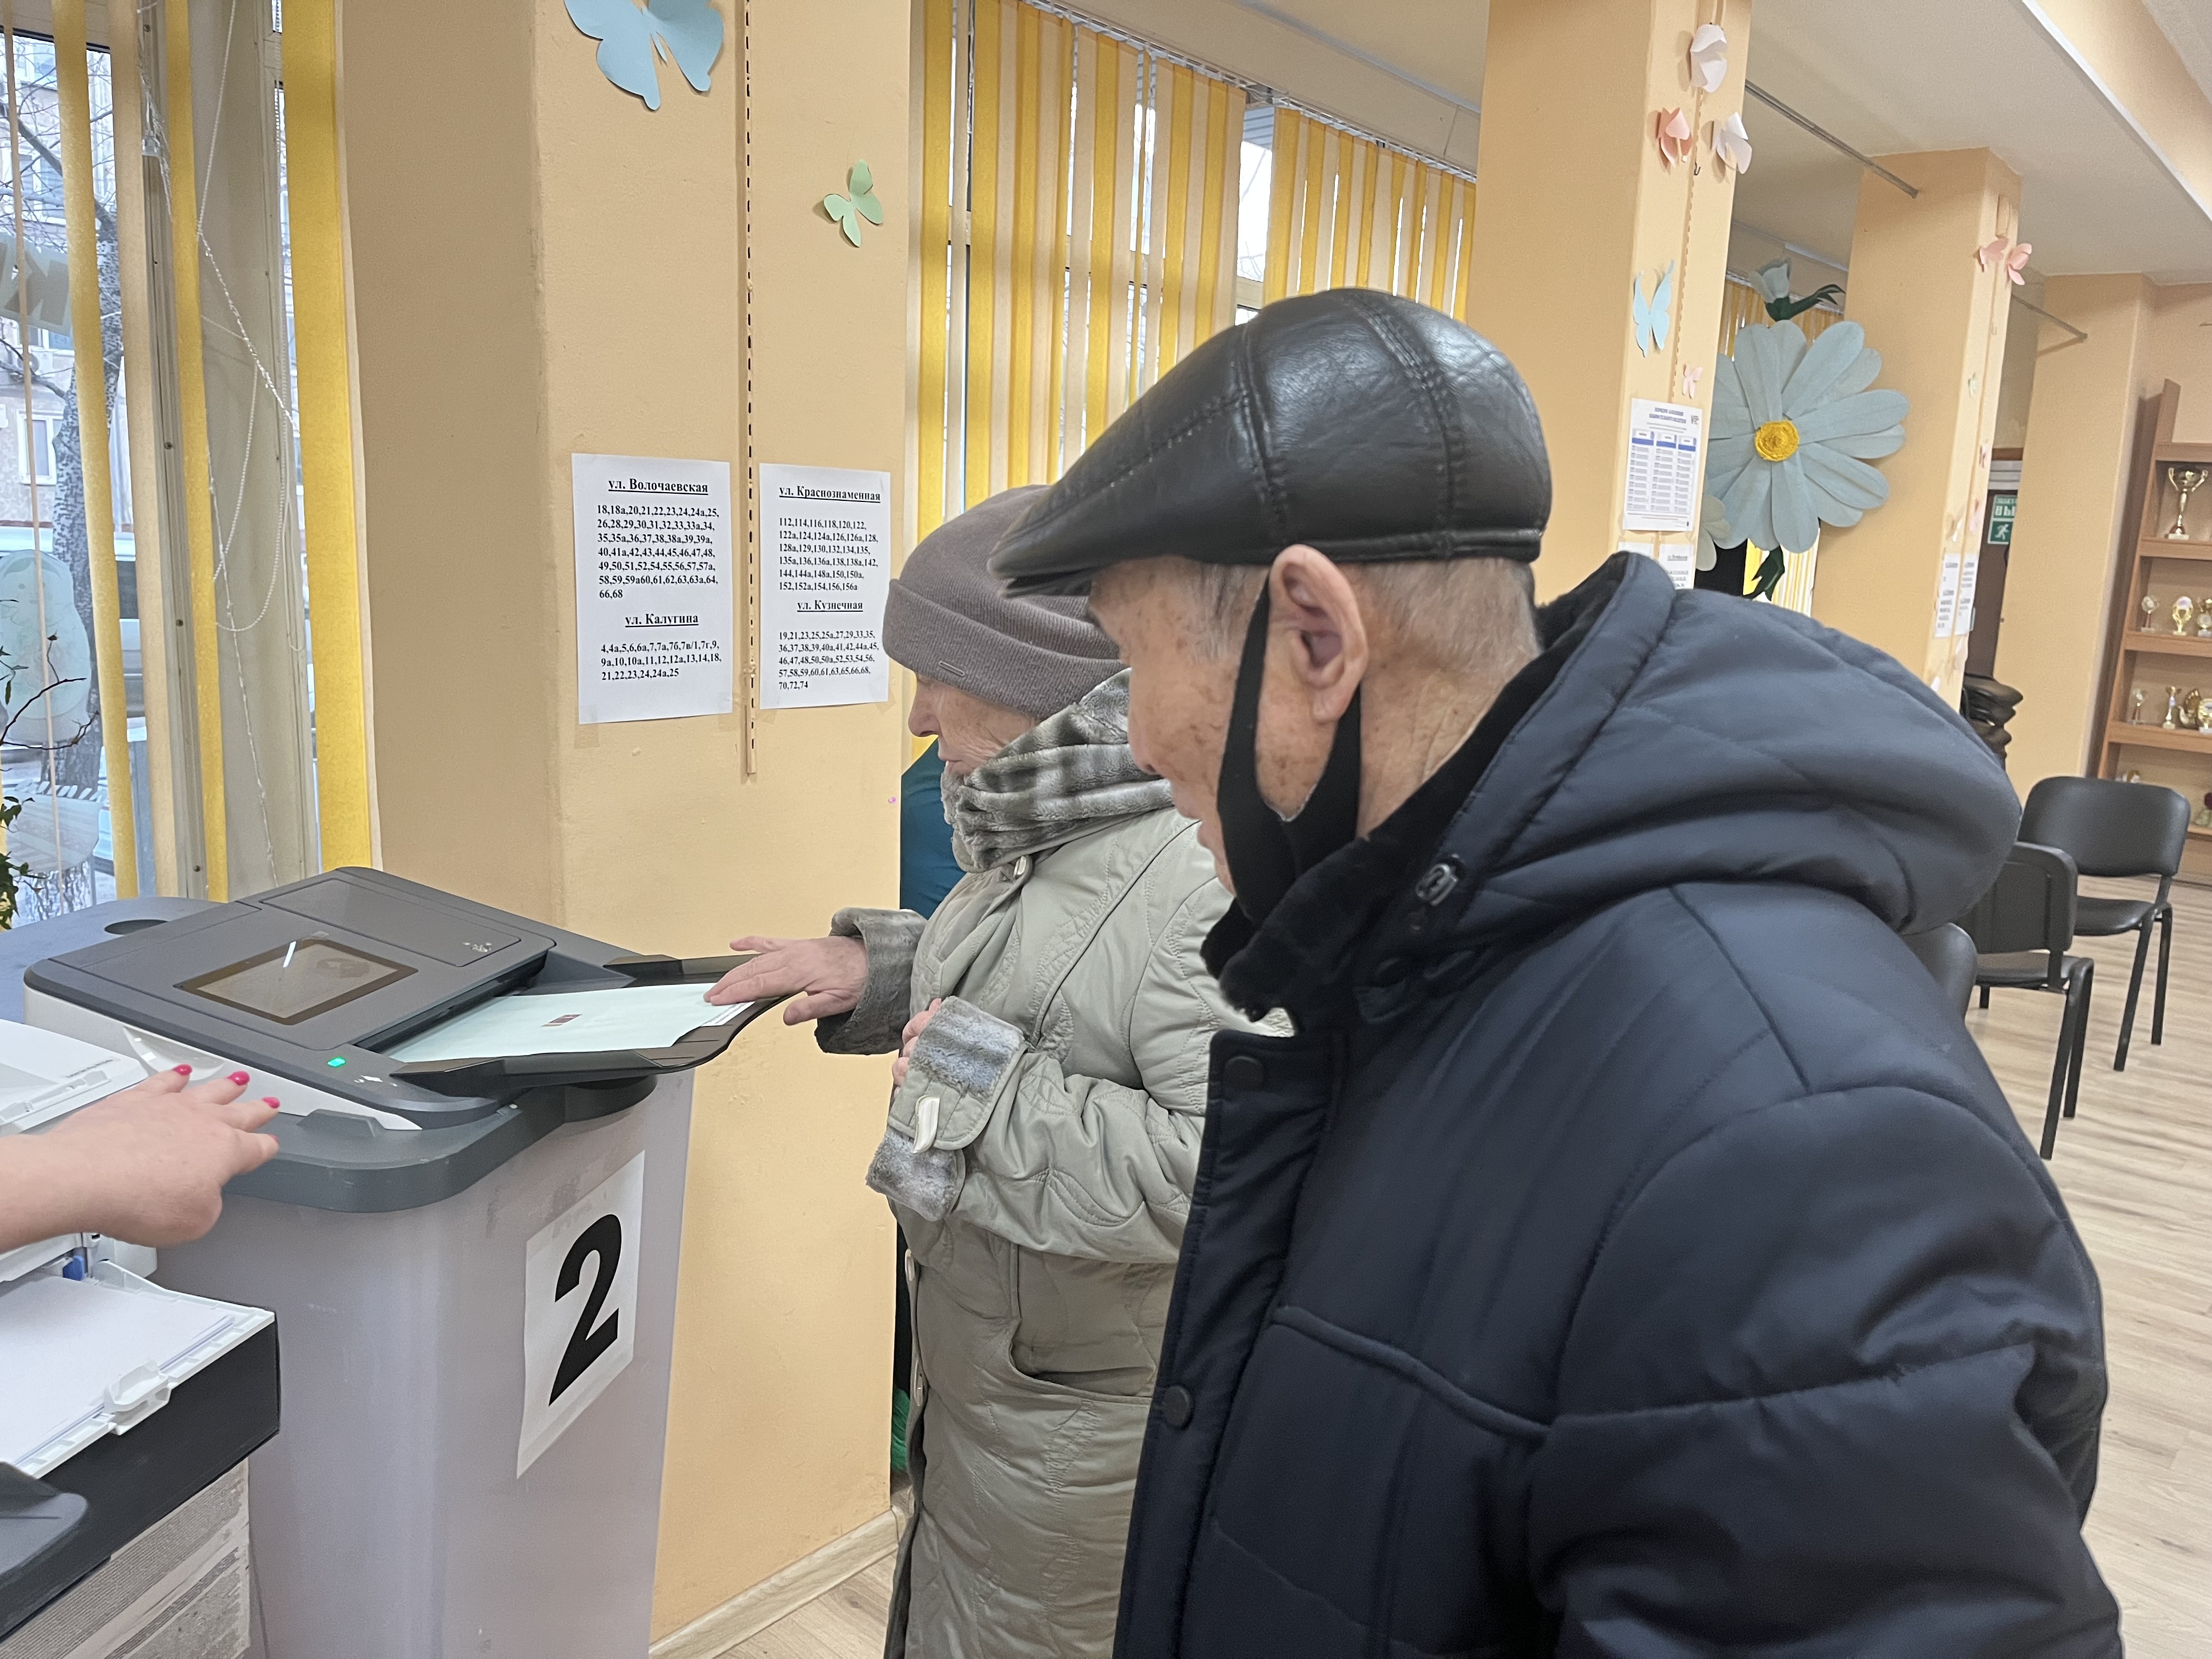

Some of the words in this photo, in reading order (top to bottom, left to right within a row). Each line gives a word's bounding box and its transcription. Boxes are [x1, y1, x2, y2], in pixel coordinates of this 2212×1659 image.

[608, 479, 625, 490] ул.
[629, 478, 708, 493] Волочаевская
[780, 487, 794, 496] ул.
[797, 486, 881, 500] Краснознаменная
[599, 589, 623, 599] 66,68
[814, 600, 863, 610] Кузнечная
[625, 616, 642, 625] ул.
[646, 613, 698, 625] Калугина
[779, 681, 808, 690] 70,72,74
[549, 1214, 622, 1407] 2
